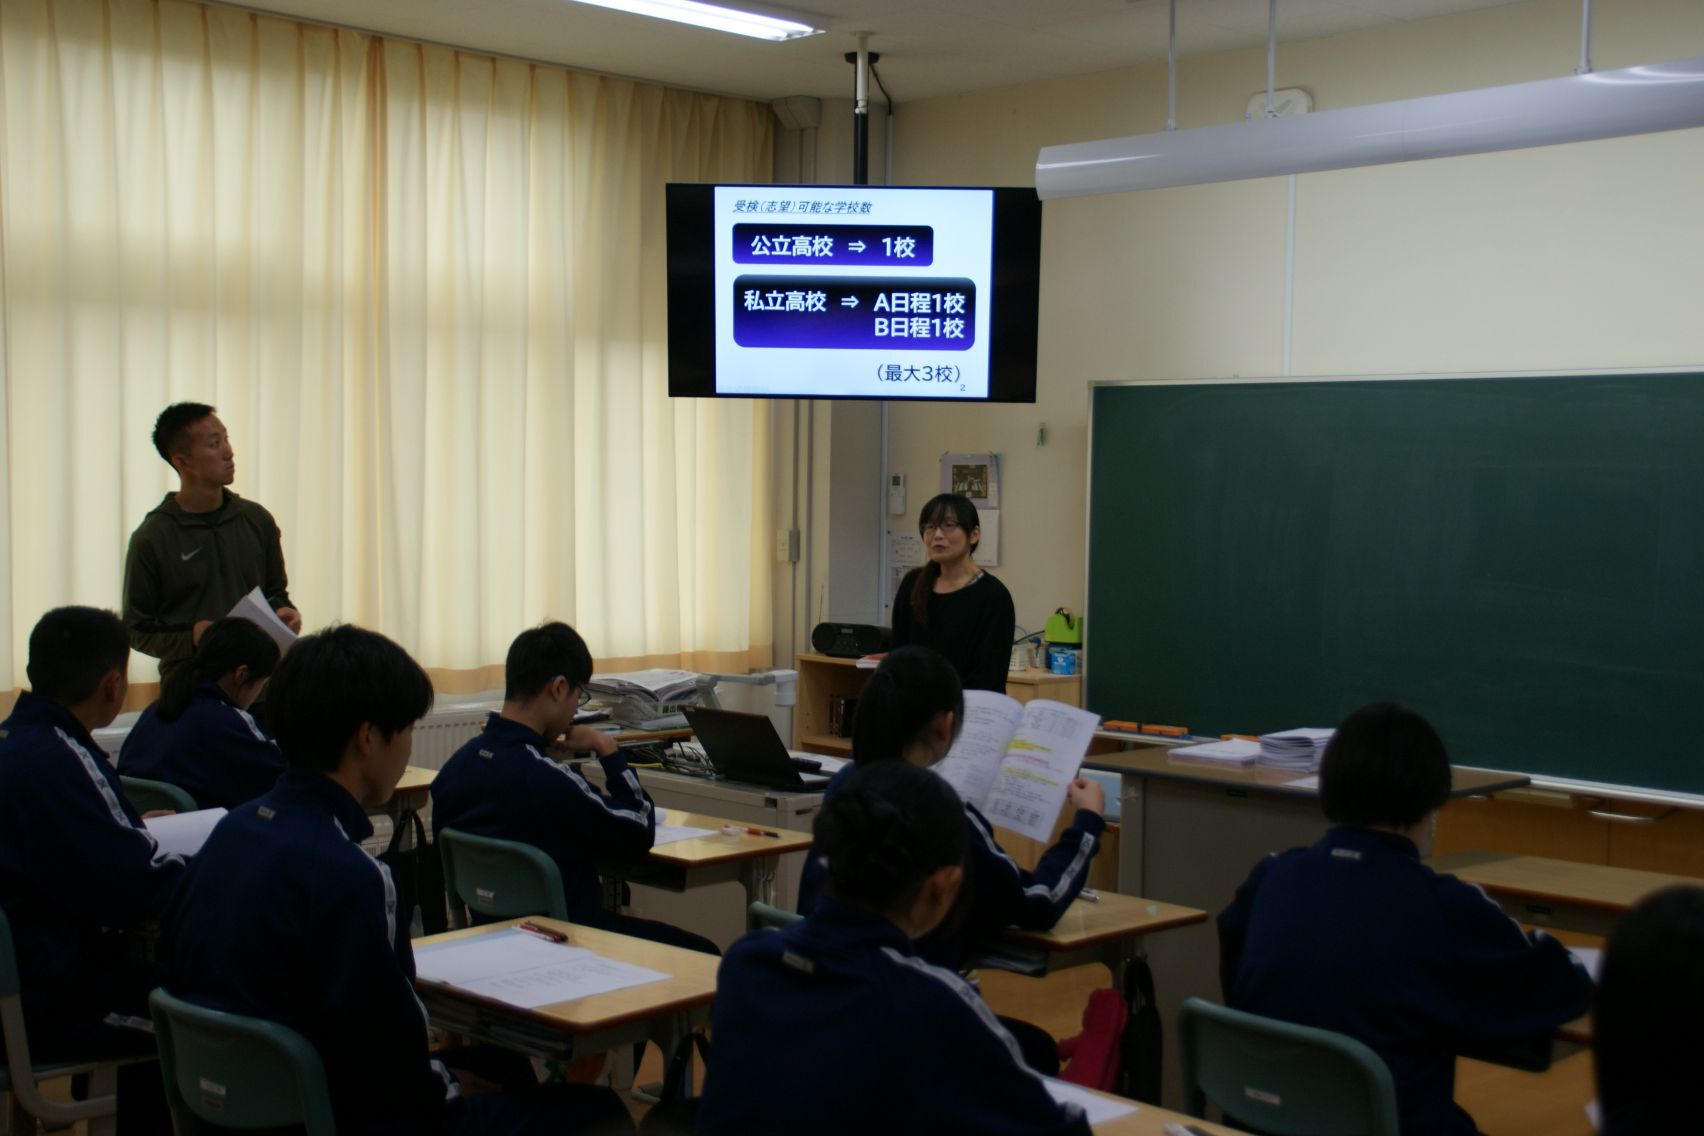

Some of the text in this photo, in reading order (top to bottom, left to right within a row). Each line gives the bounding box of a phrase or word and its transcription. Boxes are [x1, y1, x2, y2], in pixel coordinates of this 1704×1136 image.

[751, 235, 916, 258] 公立高校 1校
[743, 290, 965, 314] 私立高校 A日程1校
[874, 316, 965, 339] B日程1校
[959, 383, 966, 392] 2
